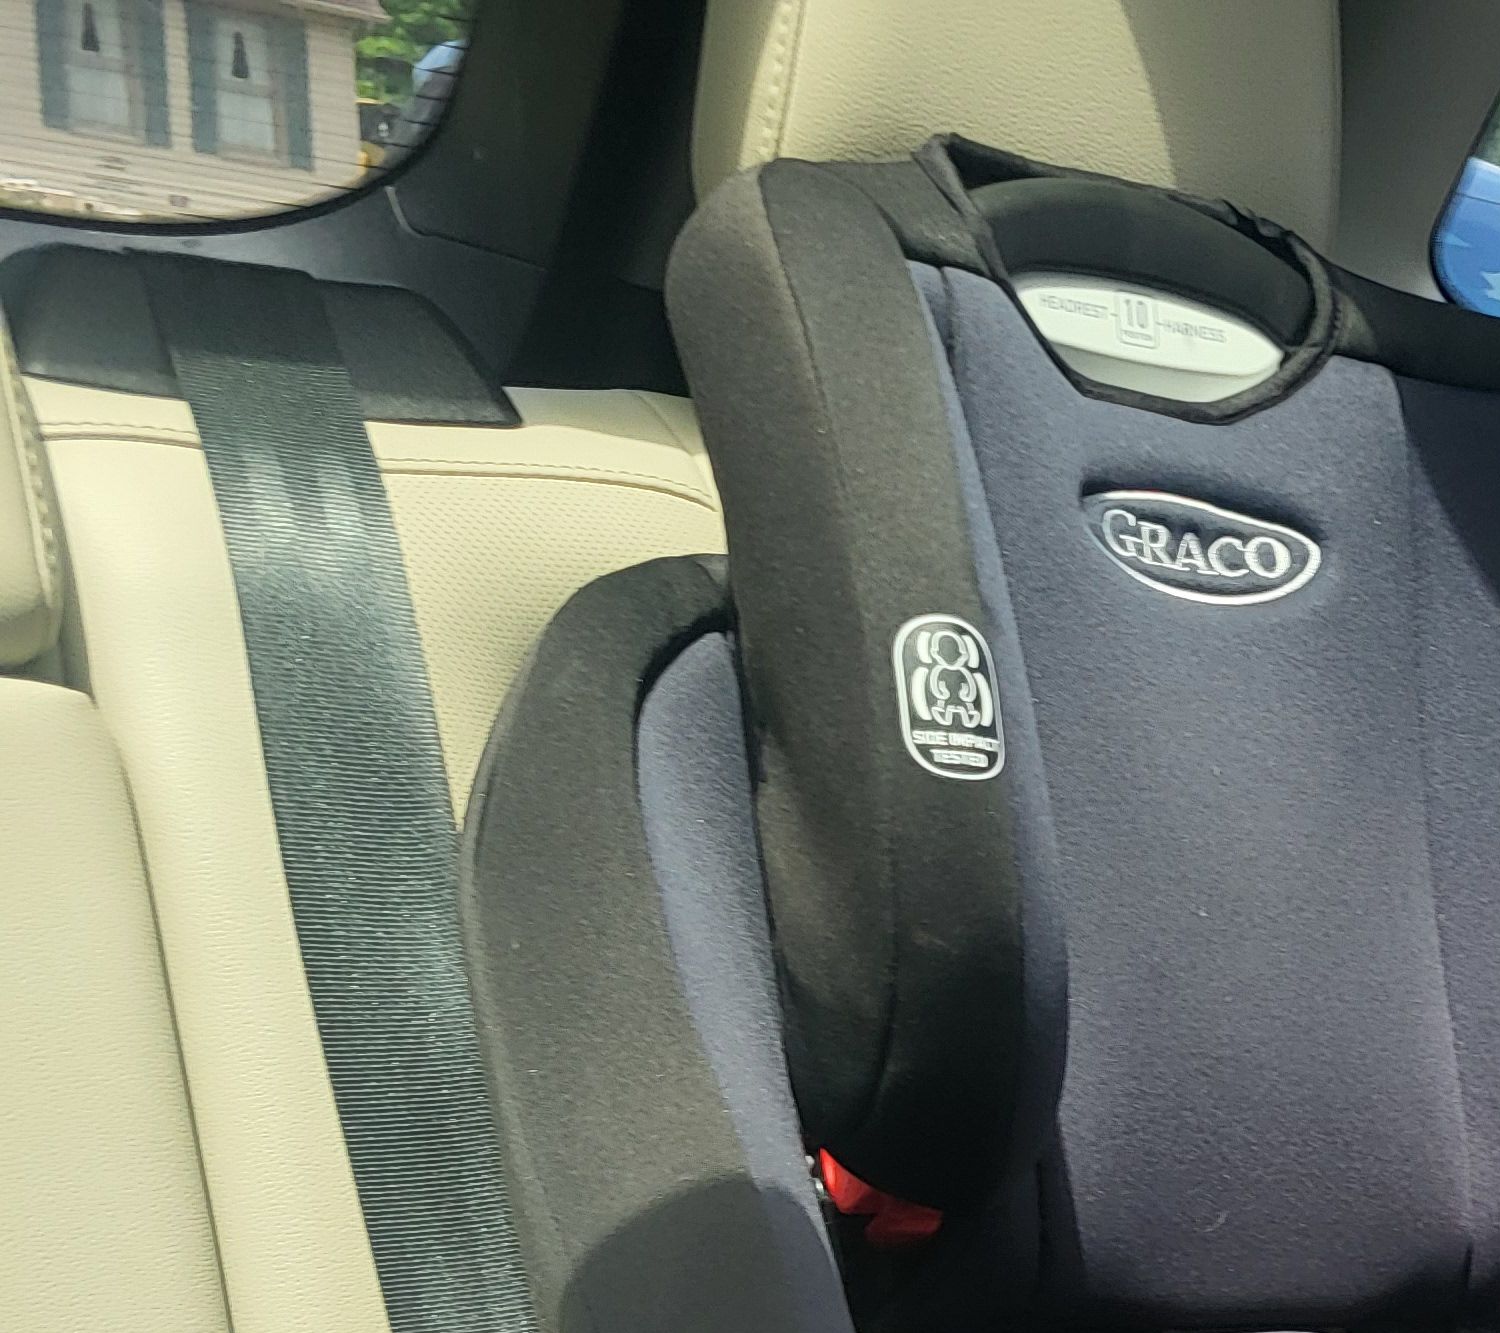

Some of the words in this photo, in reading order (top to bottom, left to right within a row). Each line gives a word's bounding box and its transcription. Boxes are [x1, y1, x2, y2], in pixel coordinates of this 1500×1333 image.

[1124, 297, 1148, 330] 10
[1163, 318, 1227, 343] HARNESS
[1101, 508, 1293, 580] GRACO
